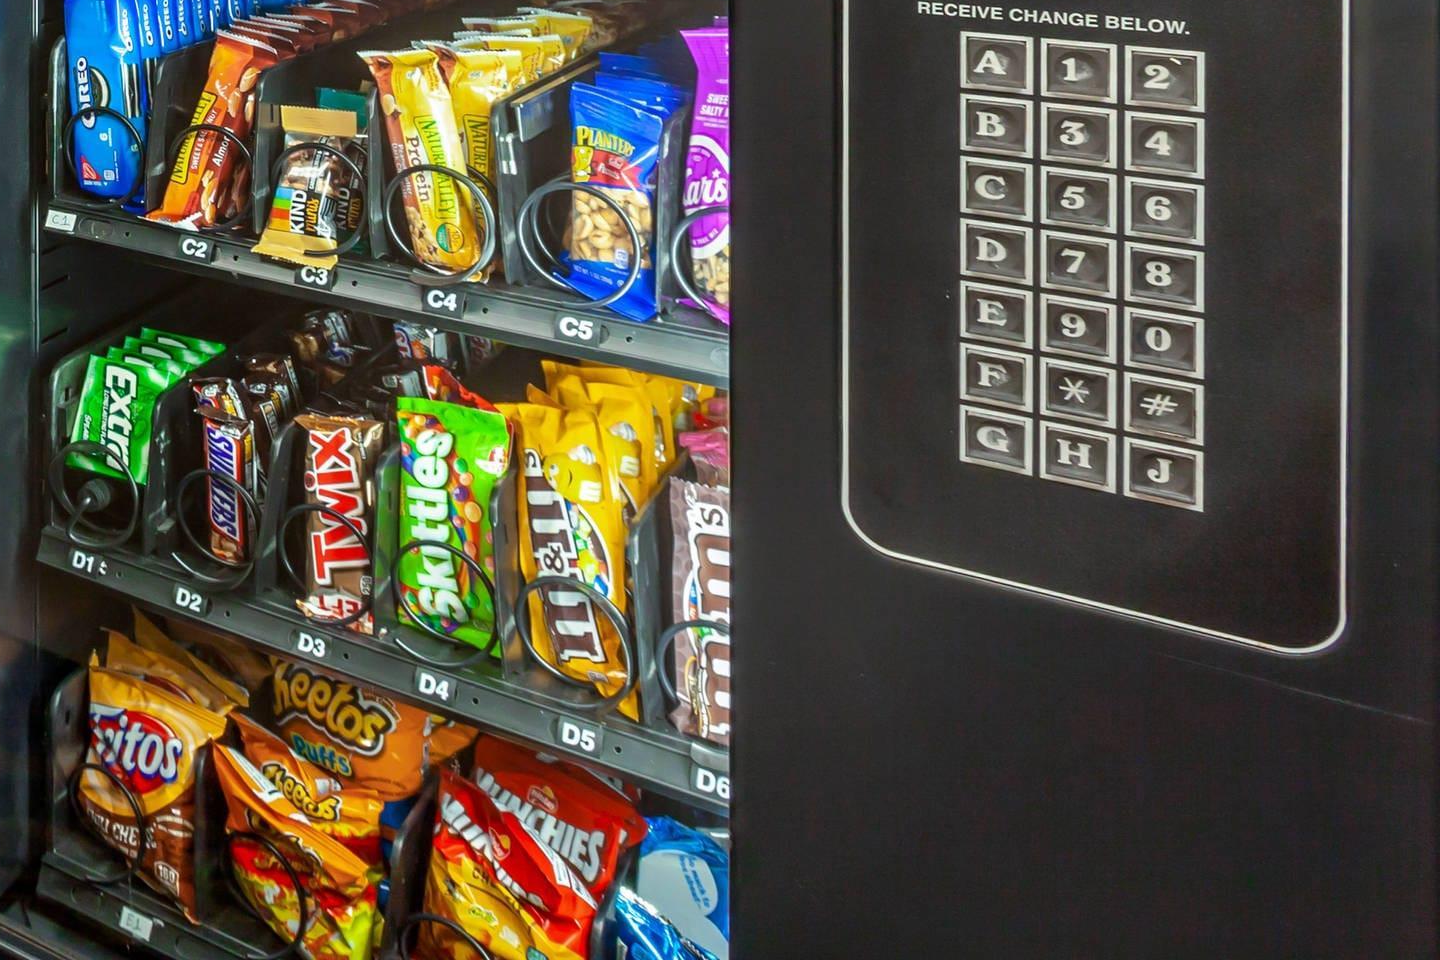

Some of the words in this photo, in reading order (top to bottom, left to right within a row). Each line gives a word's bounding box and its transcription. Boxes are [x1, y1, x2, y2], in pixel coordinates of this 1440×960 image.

[143, 3, 154, 46] OREO
[917, 1, 1003, 20] RECEIVE
[1009, 8, 1099, 28] CHANGE
[1105, 15, 1190, 36] BELOW.
[973, 50, 1007, 76] A
[1061, 57, 1079, 82] 1
[1143, 64, 1171, 90] 2
[77, 57, 96, 128] OREO
[700, 104, 724, 118] SALTY
[206, 109, 218, 124] NUT
[975, 111, 1006, 138] B
[1059, 120, 1085, 146] 3
[1144, 131, 1172, 157] 4
[212, 126, 235, 167] Almo
[576, 125, 636, 157] PLANTERS
[406, 135, 431, 202] Proein
[290, 189, 307, 234] KIND
[437, 170, 456, 215] ALLEY
[974, 174, 1006, 201] C
[1060, 186, 1086, 210] 5
[1145, 196, 1172, 222] 6
[52, 215, 70, 226] C1
[304, 197, 320, 232] minis
[182, 238, 208, 257] C2
[975, 236, 1007, 263] D
[1061, 247, 1086, 274] 7
[1145, 260, 1172, 287] 8
[300, 267, 328, 286] C3
[427, 290, 457, 311] C4
[559, 317, 593, 341] C5
[976, 298, 1008, 328] E
[1060, 312, 1086, 338] 9
[1145, 326, 1172, 352] 0
[976, 361, 1008, 387] F
[1140, 394, 1179, 417] #
[976, 426, 1010, 453] G
[1056, 438, 1092, 469] H
[1146, 458, 1173, 484] J
[207, 425, 237, 540] SNIERS
[309, 427, 371, 587] TWIX
[407, 429, 469, 623] Skittles
[72, 550, 94, 573] D1
[175, 587, 204, 613] D2
[297, 632, 326, 657] D3
[269, 653, 387, 748] heetos
[418, 672, 450, 701] D4
[291, 732, 353, 777] Puffs
[561, 723, 596, 752] D5
[696, 769, 730, 799] D6
